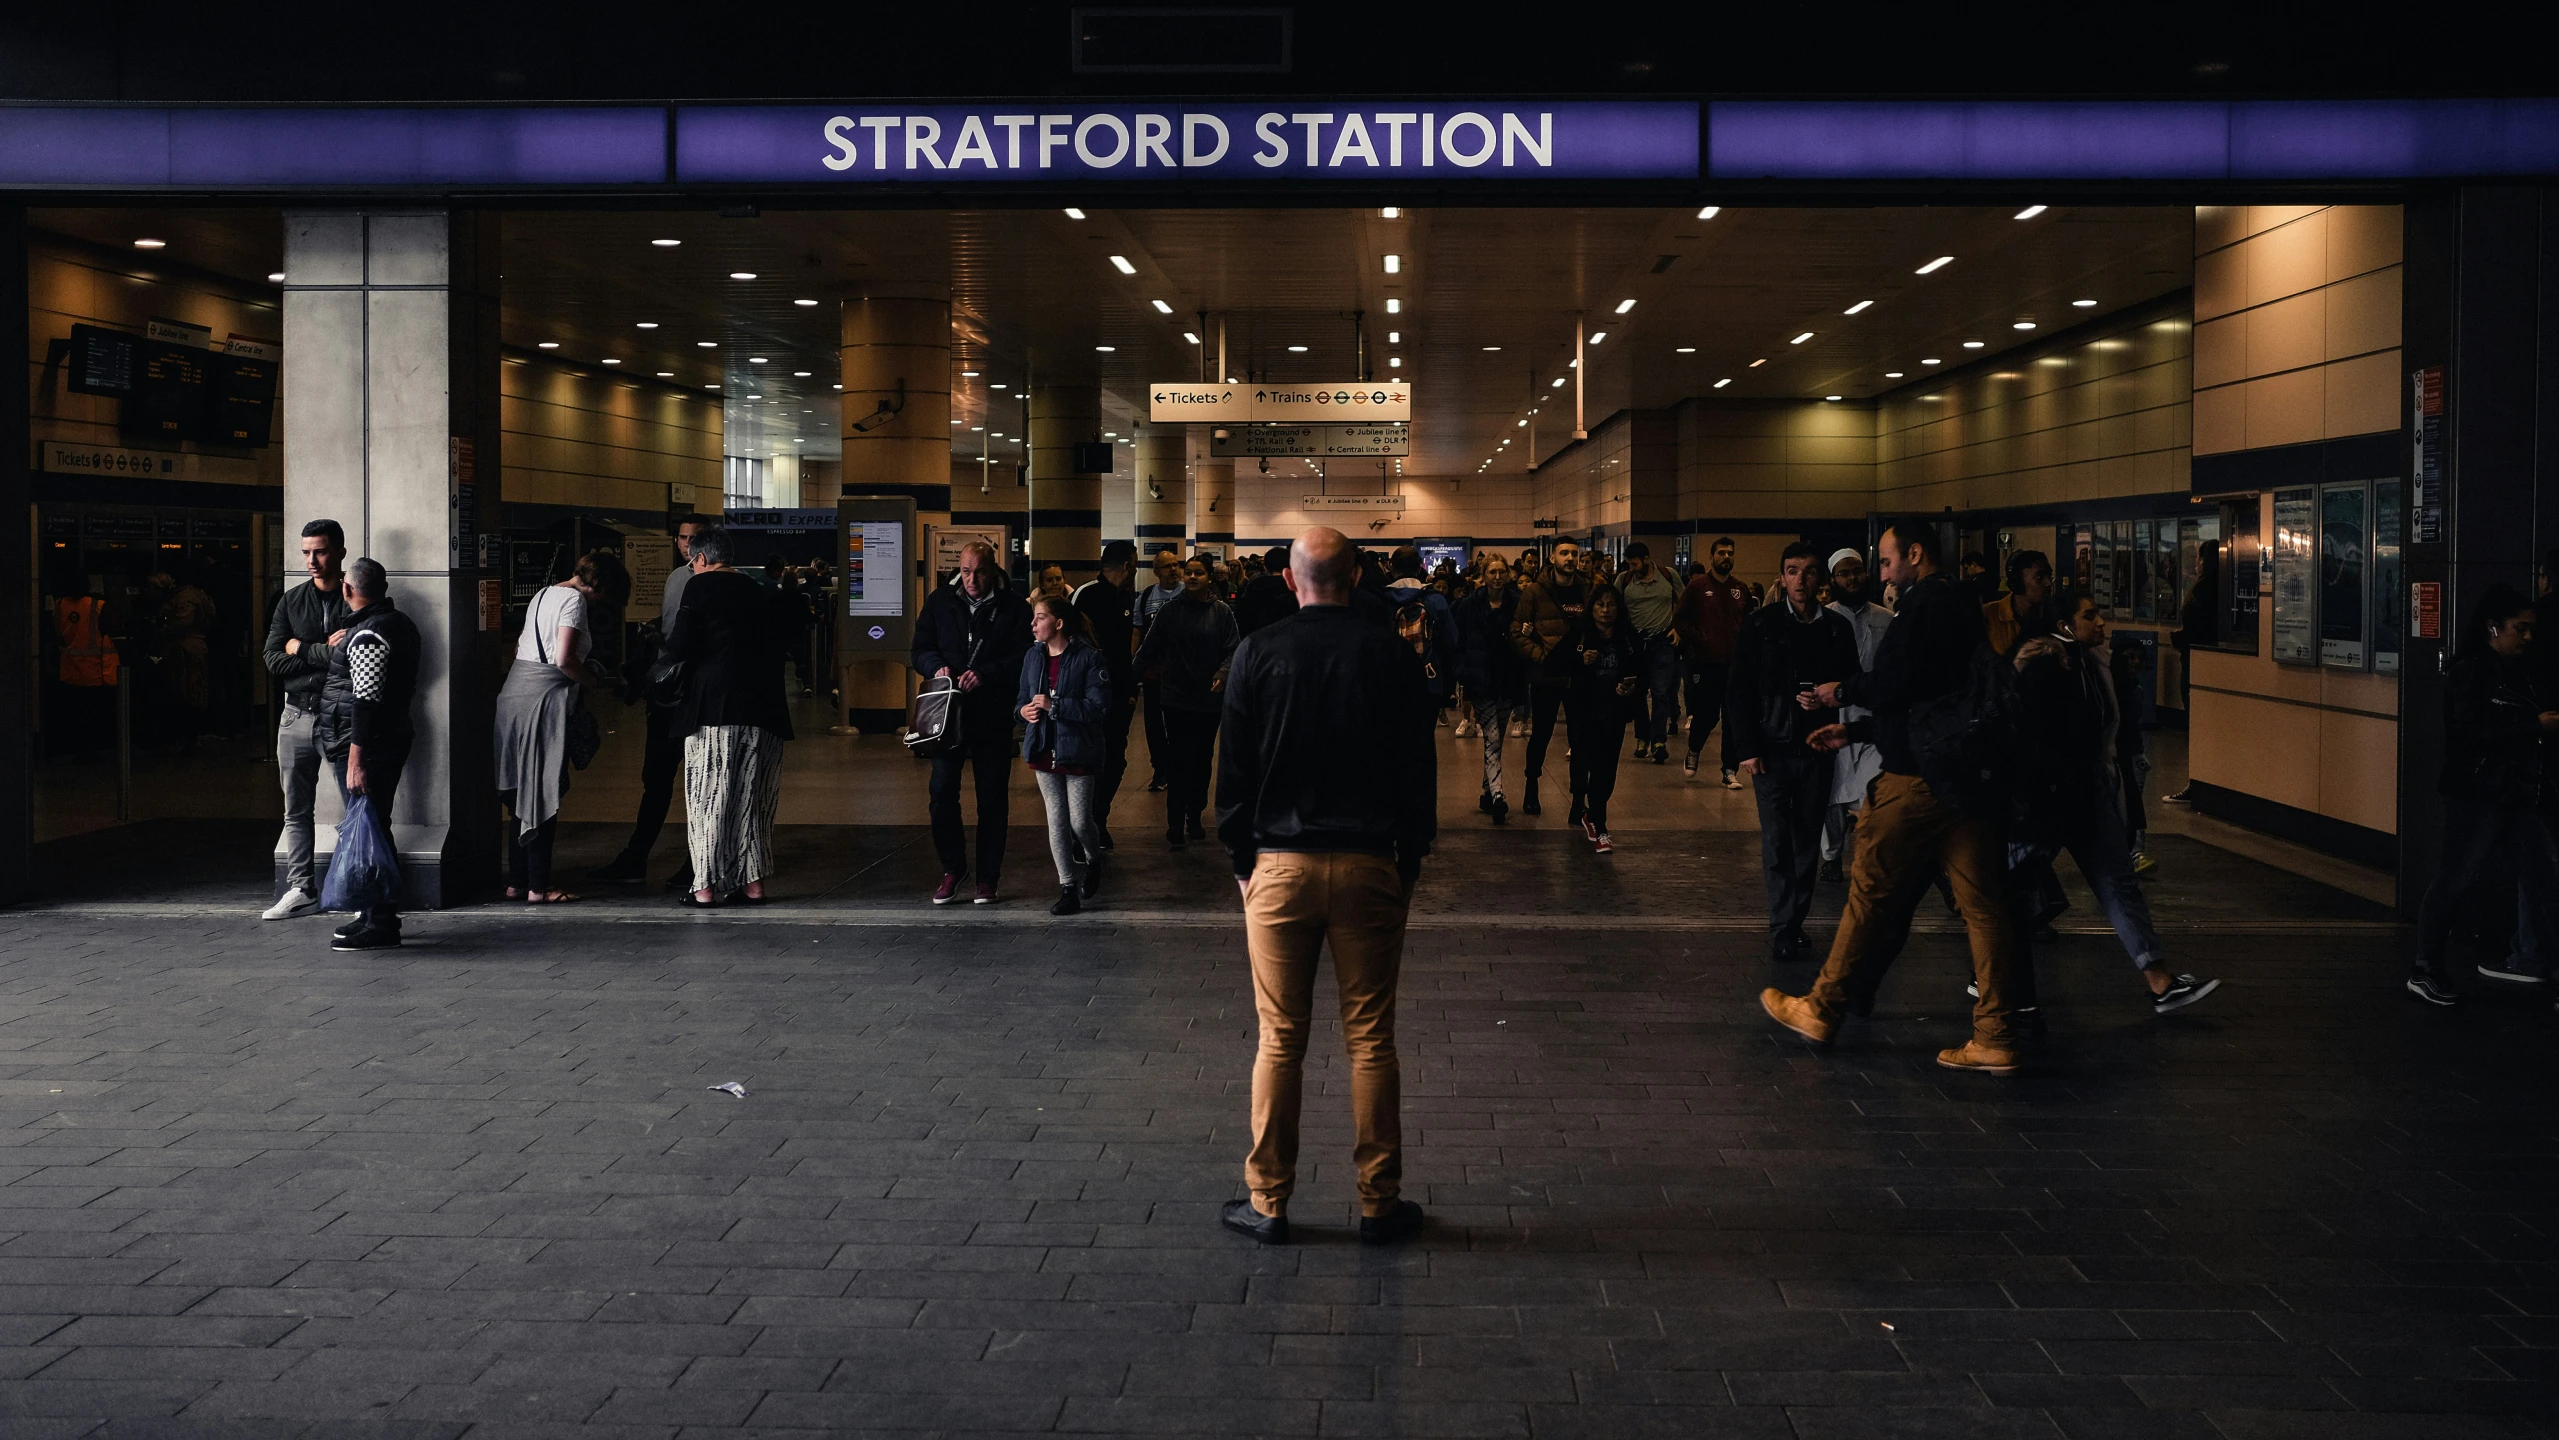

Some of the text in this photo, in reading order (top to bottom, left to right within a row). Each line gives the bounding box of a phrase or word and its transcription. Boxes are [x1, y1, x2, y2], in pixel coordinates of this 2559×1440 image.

[822, 112, 1553, 171] STRATFORD STATION
[157, 327, 189, 341] Jubilee line
[234, 343, 263, 355] Central line
[1169, 392, 1218, 404] Tickets
[1270, 391, 1312, 403] Trains
[1254, 428, 1299, 438] Overground
[1357, 428, 1384, 436] Jubilee
[56, 450, 91, 467] Tickets
[724, 512, 782, 525] NERO
